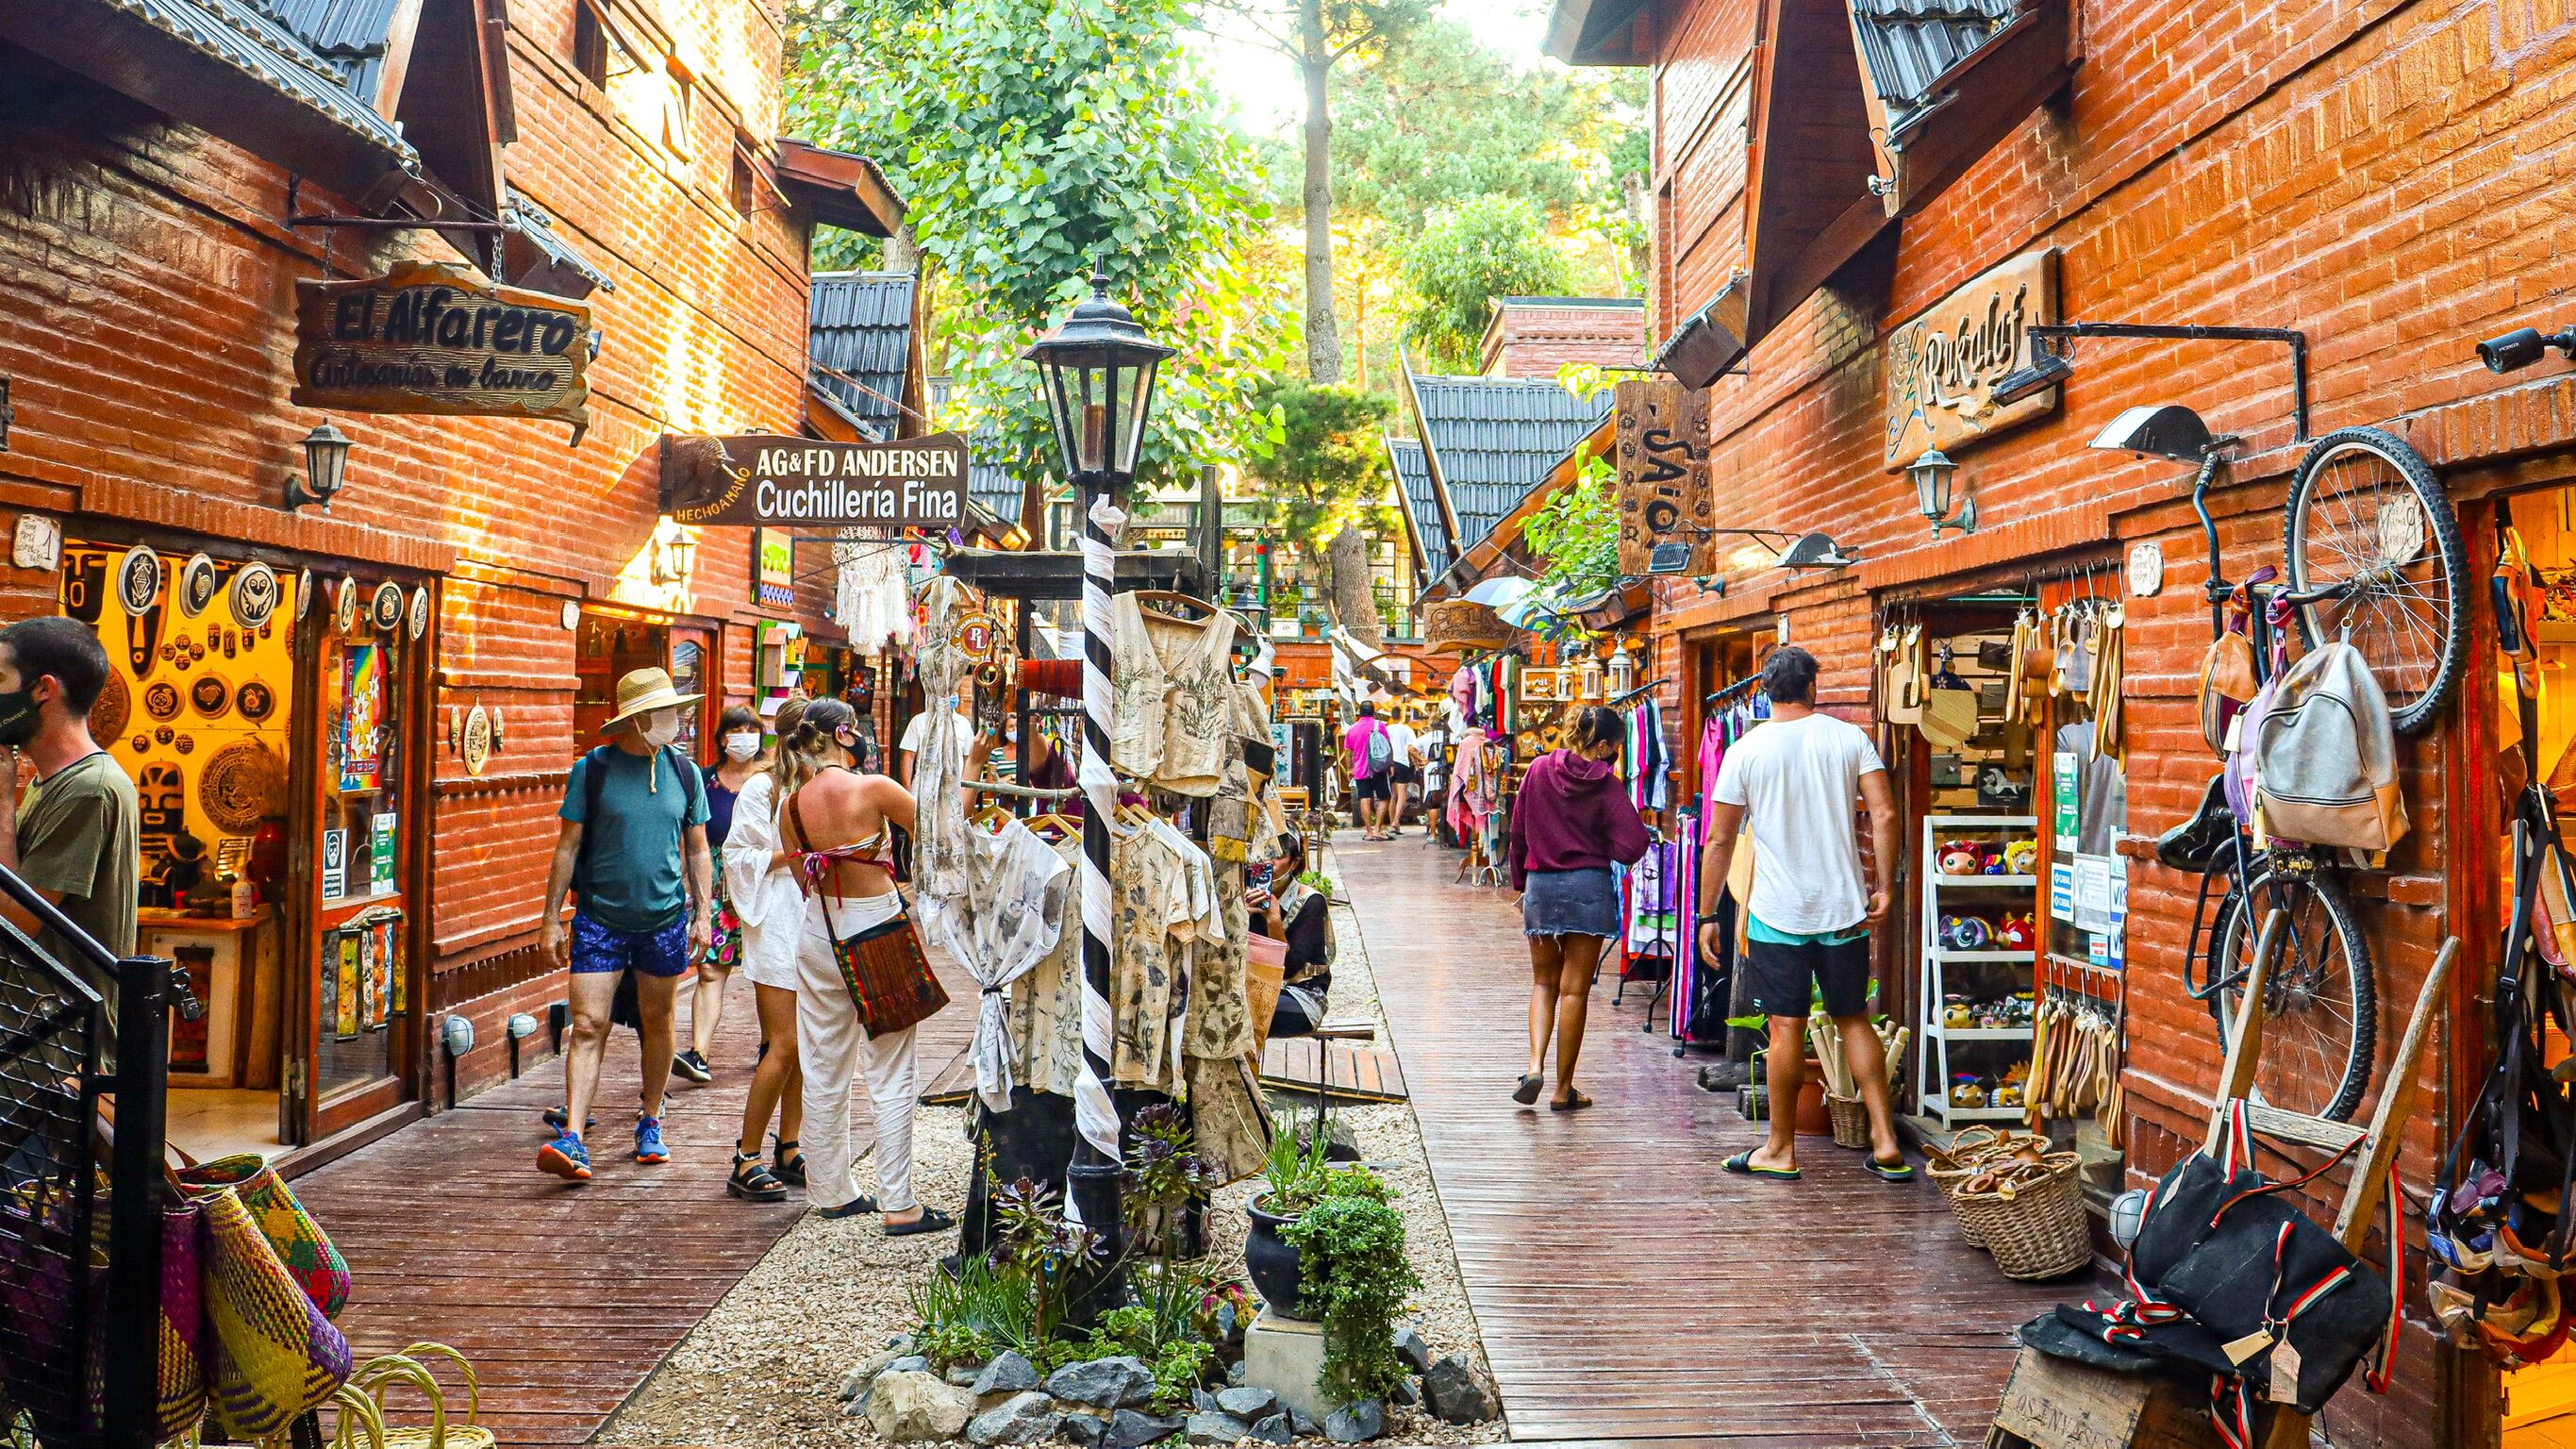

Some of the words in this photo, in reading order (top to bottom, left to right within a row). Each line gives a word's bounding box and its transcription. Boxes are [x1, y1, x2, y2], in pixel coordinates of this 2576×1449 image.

[335, 291, 375, 341] El
[384, 286, 576, 356] Alfarero
[443, 363, 472, 389] en
[478, 356, 557, 391] barro
[756, 448, 835, 477] AG&FD
[842, 449, 958, 477] ANDERSEN
[724, 466, 751, 504] MANO
[756, 479, 895, 519] Cuchillería
[903, 480, 958, 519] Fina
[676, 503, 721, 522] HECHO
[719, 499, 730, 510] A
[42, 529, 53, 561] 1
[2149, 553, 2156, 586] 8
